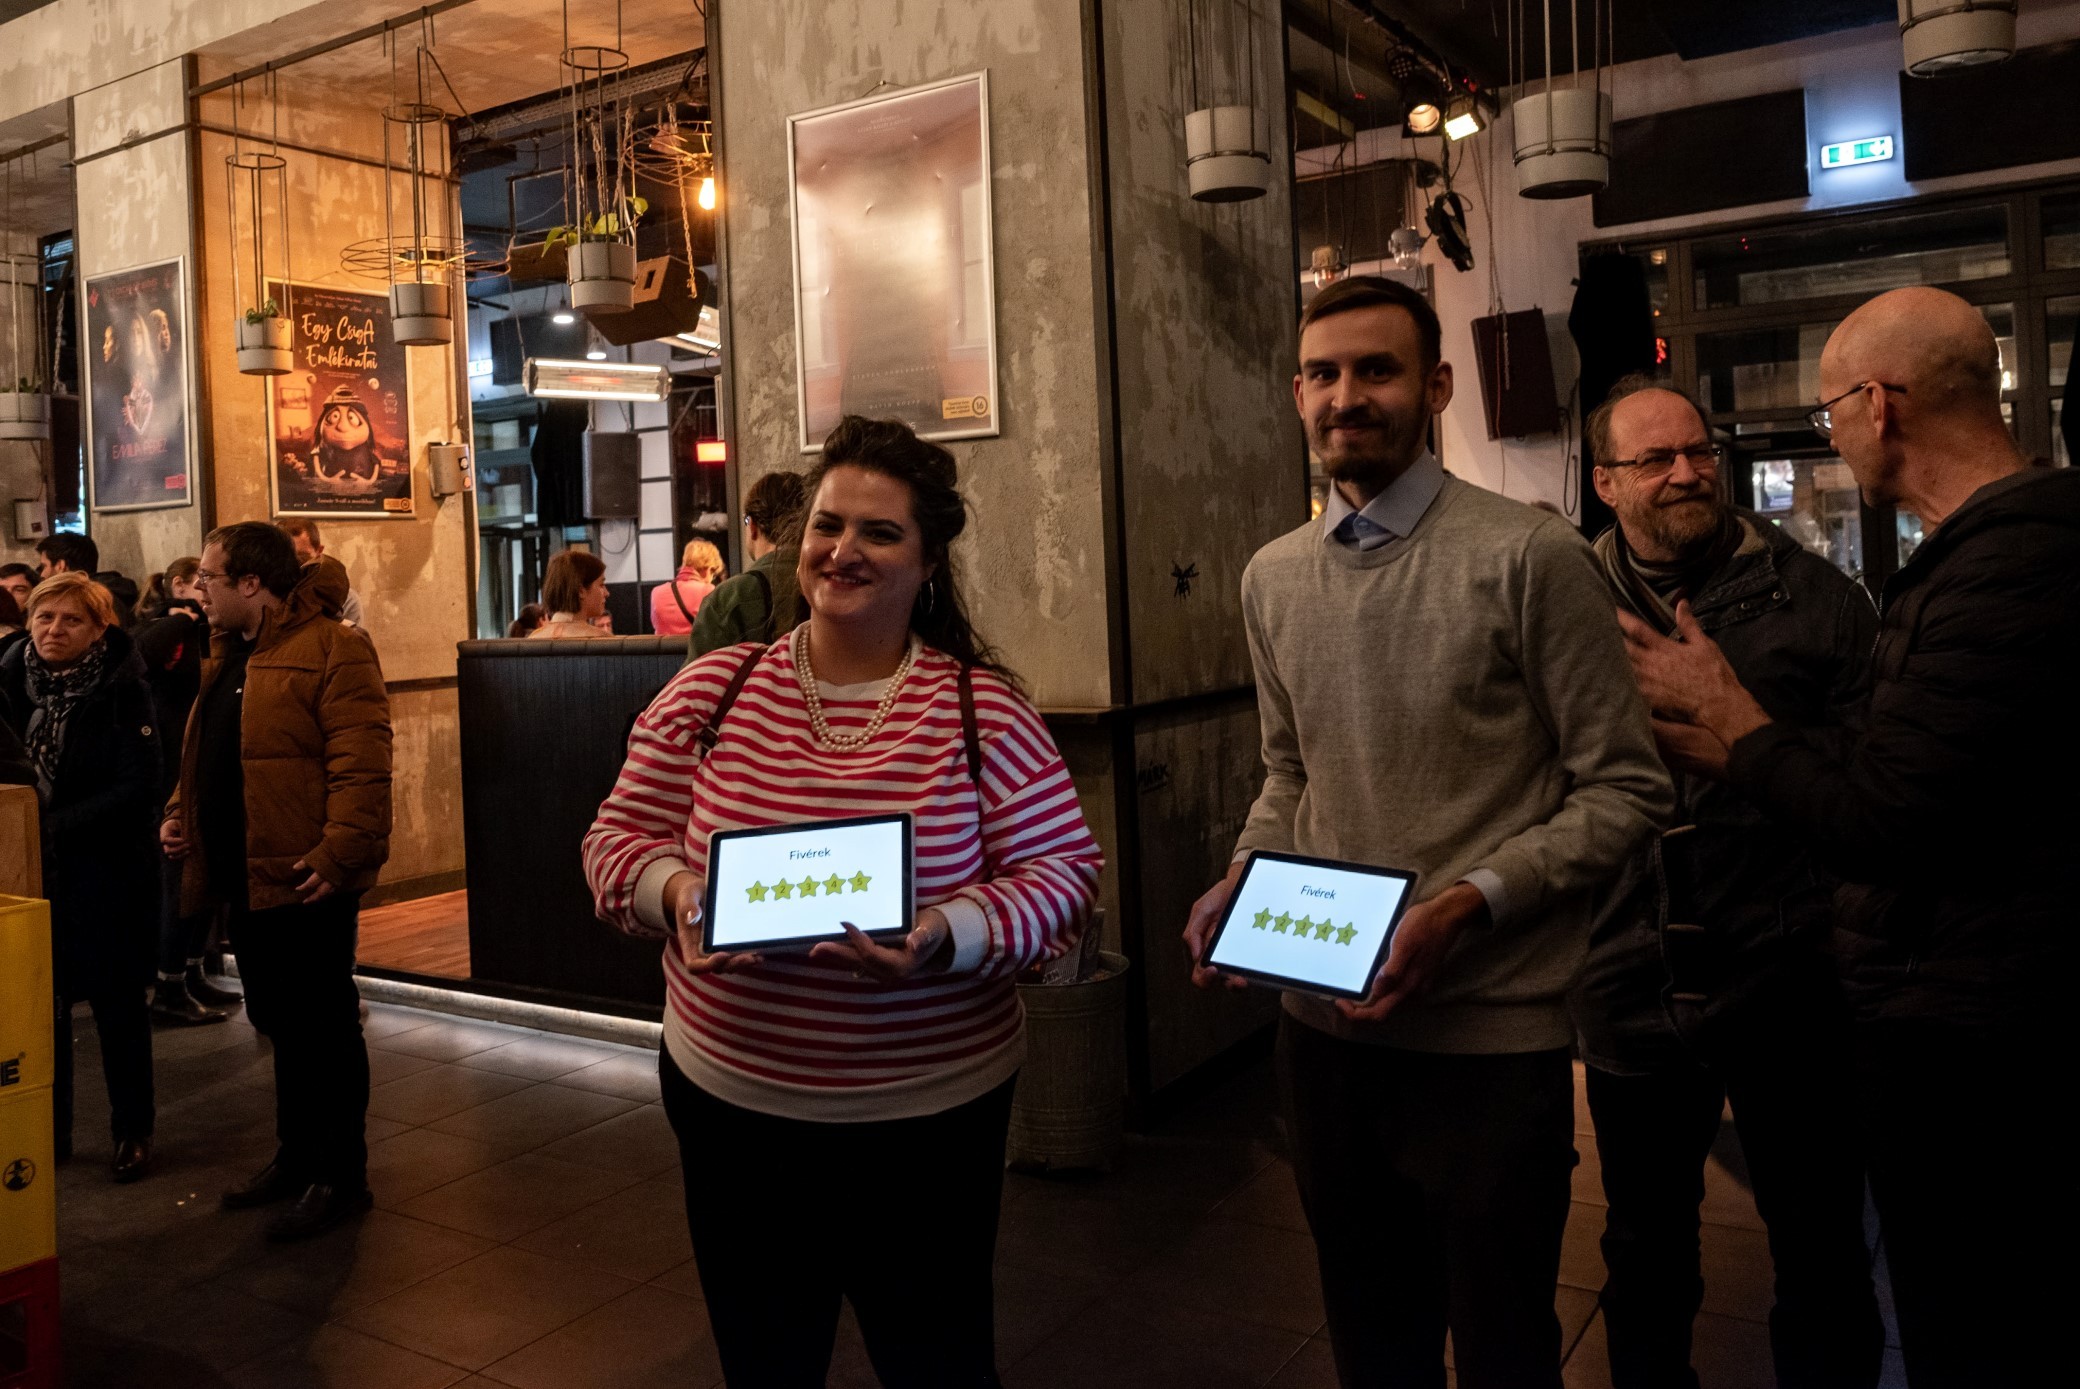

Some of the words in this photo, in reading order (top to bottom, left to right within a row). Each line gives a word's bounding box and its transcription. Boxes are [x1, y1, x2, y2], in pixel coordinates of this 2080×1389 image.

[302, 312, 333, 343] Egy
[305, 343, 378, 370] Emlékiratai
[976, 401, 984, 410] 16
[789, 847, 832, 861] Fivérek
[780, 885, 786, 894] 2
[1300, 885, 1336, 900] Fivérek
[1279, 918, 1286, 927] 2
[1300, 921, 1307, 931] 3
[1322, 925, 1329, 934] 4
[1342, 929, 1350, 938] 5
